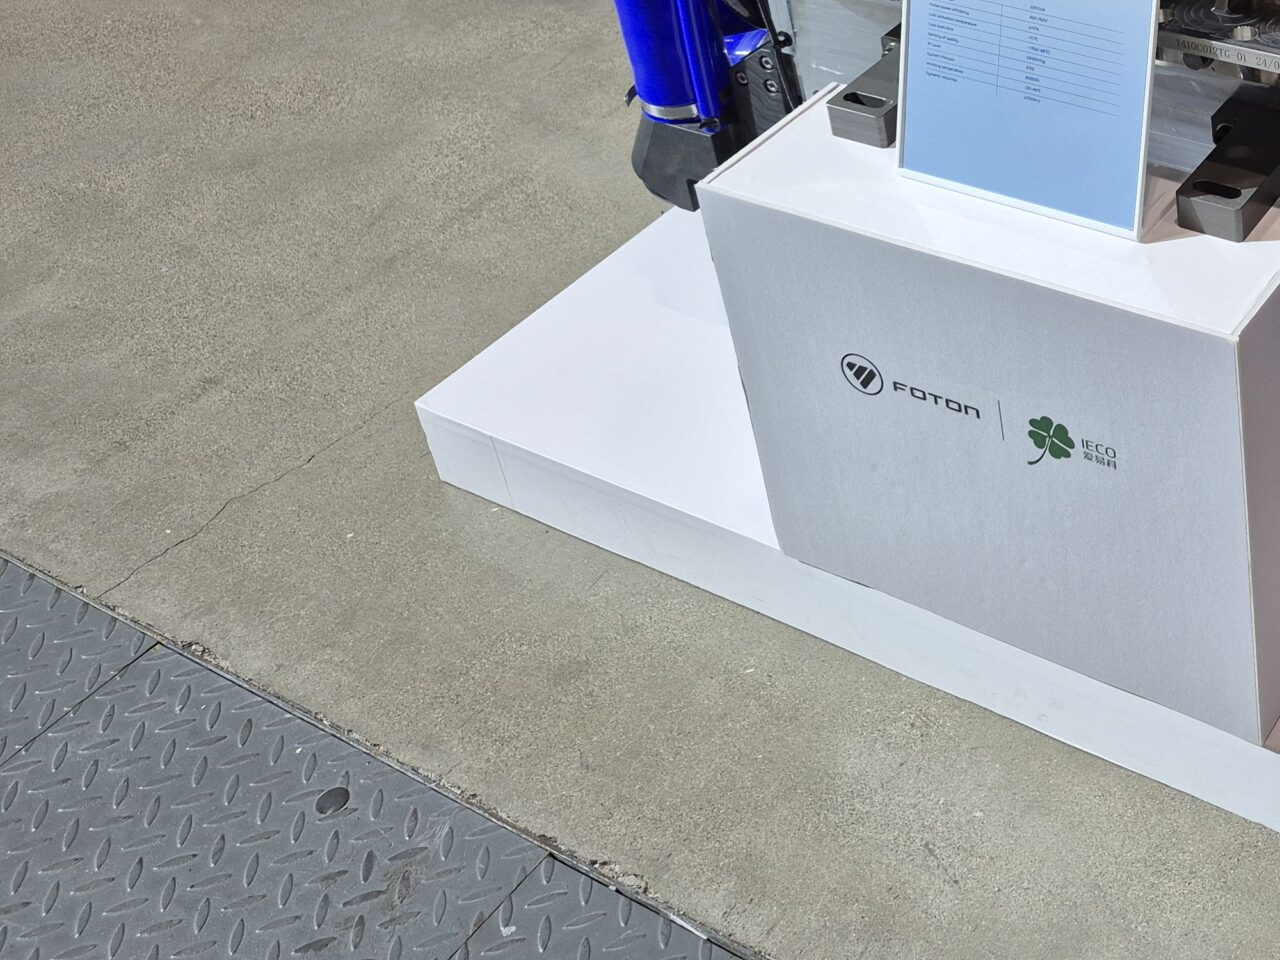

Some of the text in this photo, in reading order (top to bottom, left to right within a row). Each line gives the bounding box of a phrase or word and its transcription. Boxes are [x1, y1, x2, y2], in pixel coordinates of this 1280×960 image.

[1176, 38, 1247, 63] 1410C012TG-01
[892, 380, 981, 419] FOTON
[1081, 438, 1117, 459] IECO
